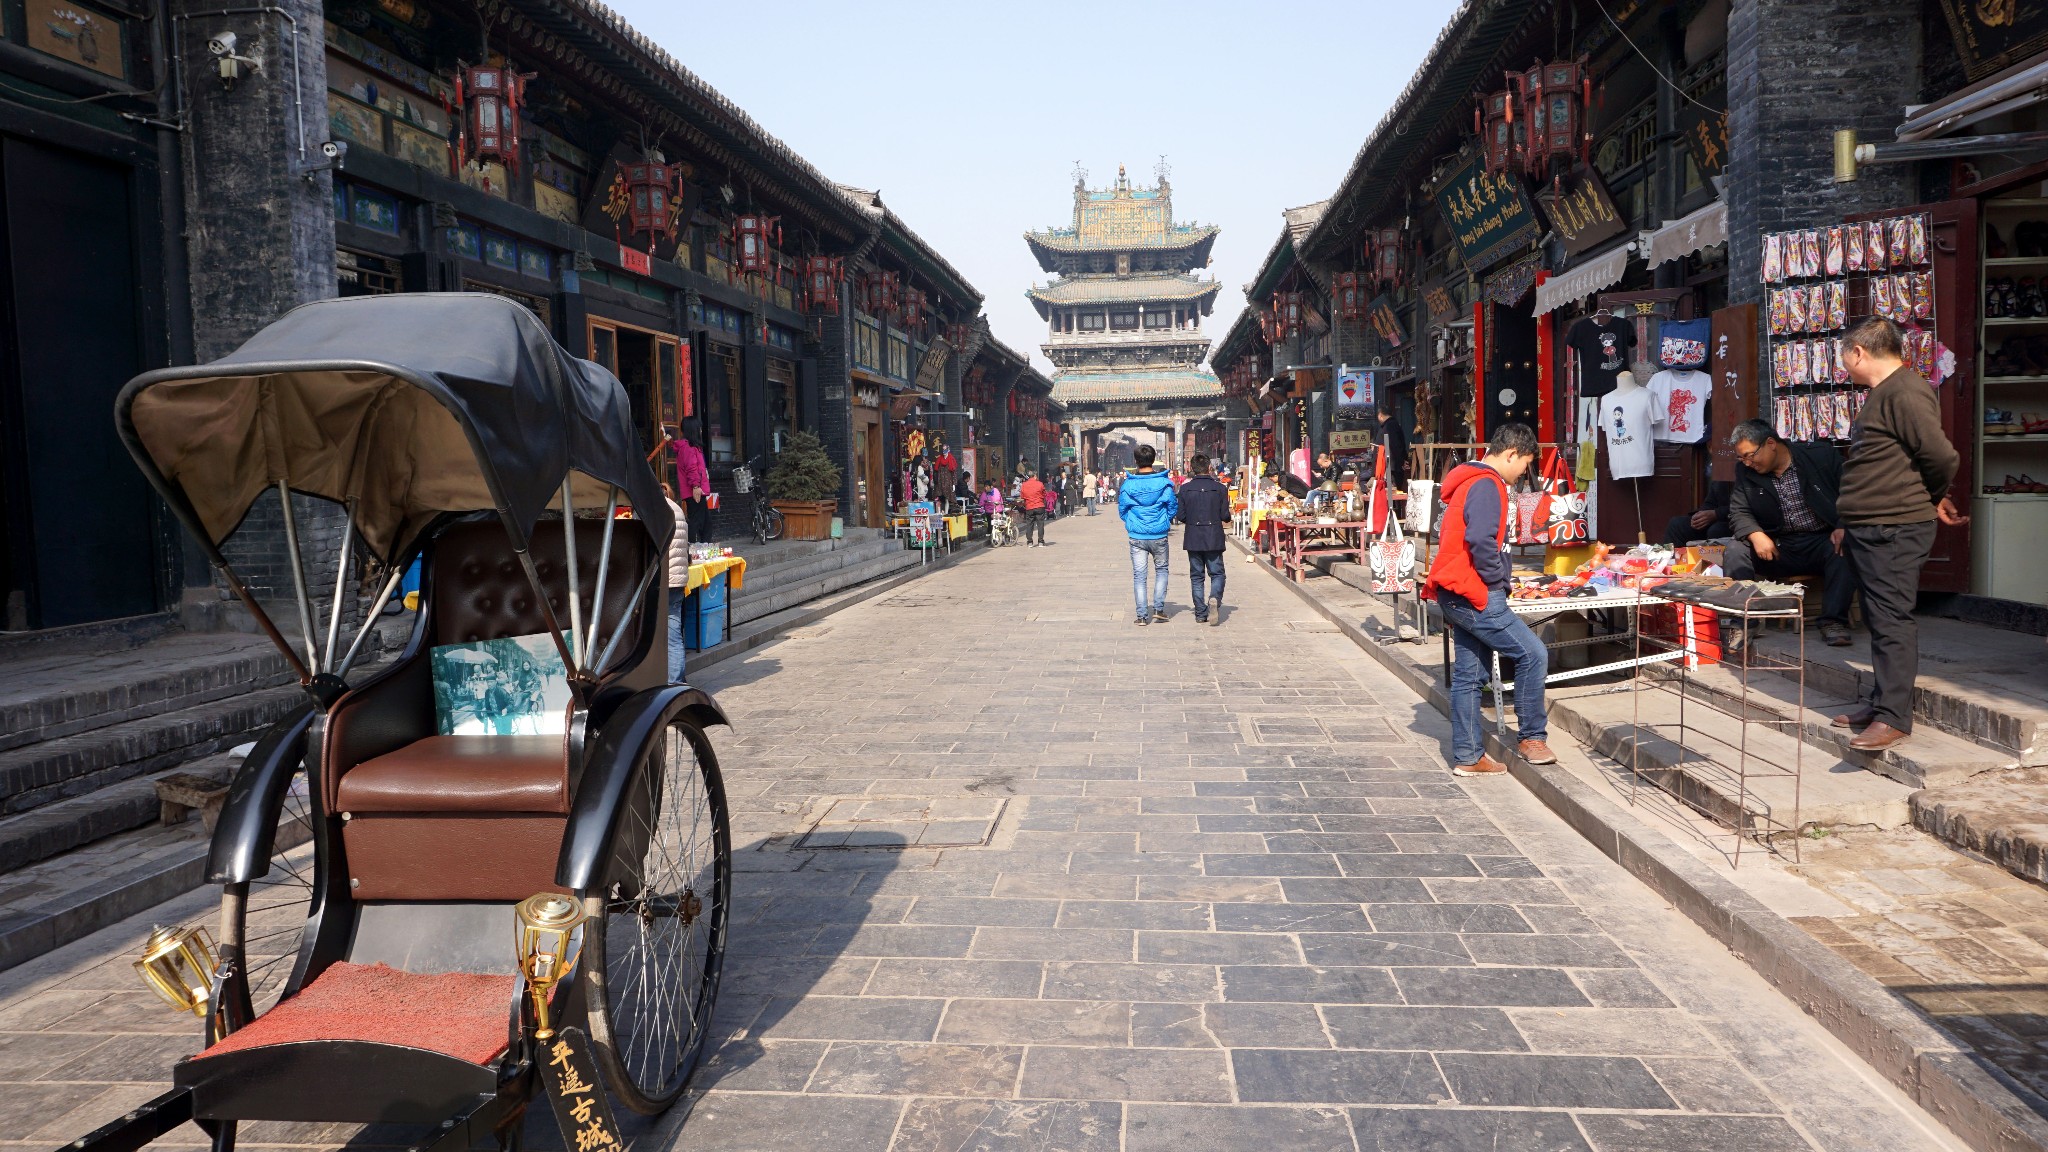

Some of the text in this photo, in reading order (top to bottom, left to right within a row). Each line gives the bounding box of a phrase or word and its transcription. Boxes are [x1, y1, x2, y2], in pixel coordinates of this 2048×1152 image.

[1500, 197, 1523, 221] Hotel
[1344, 433, 1367, 443] 售票点
